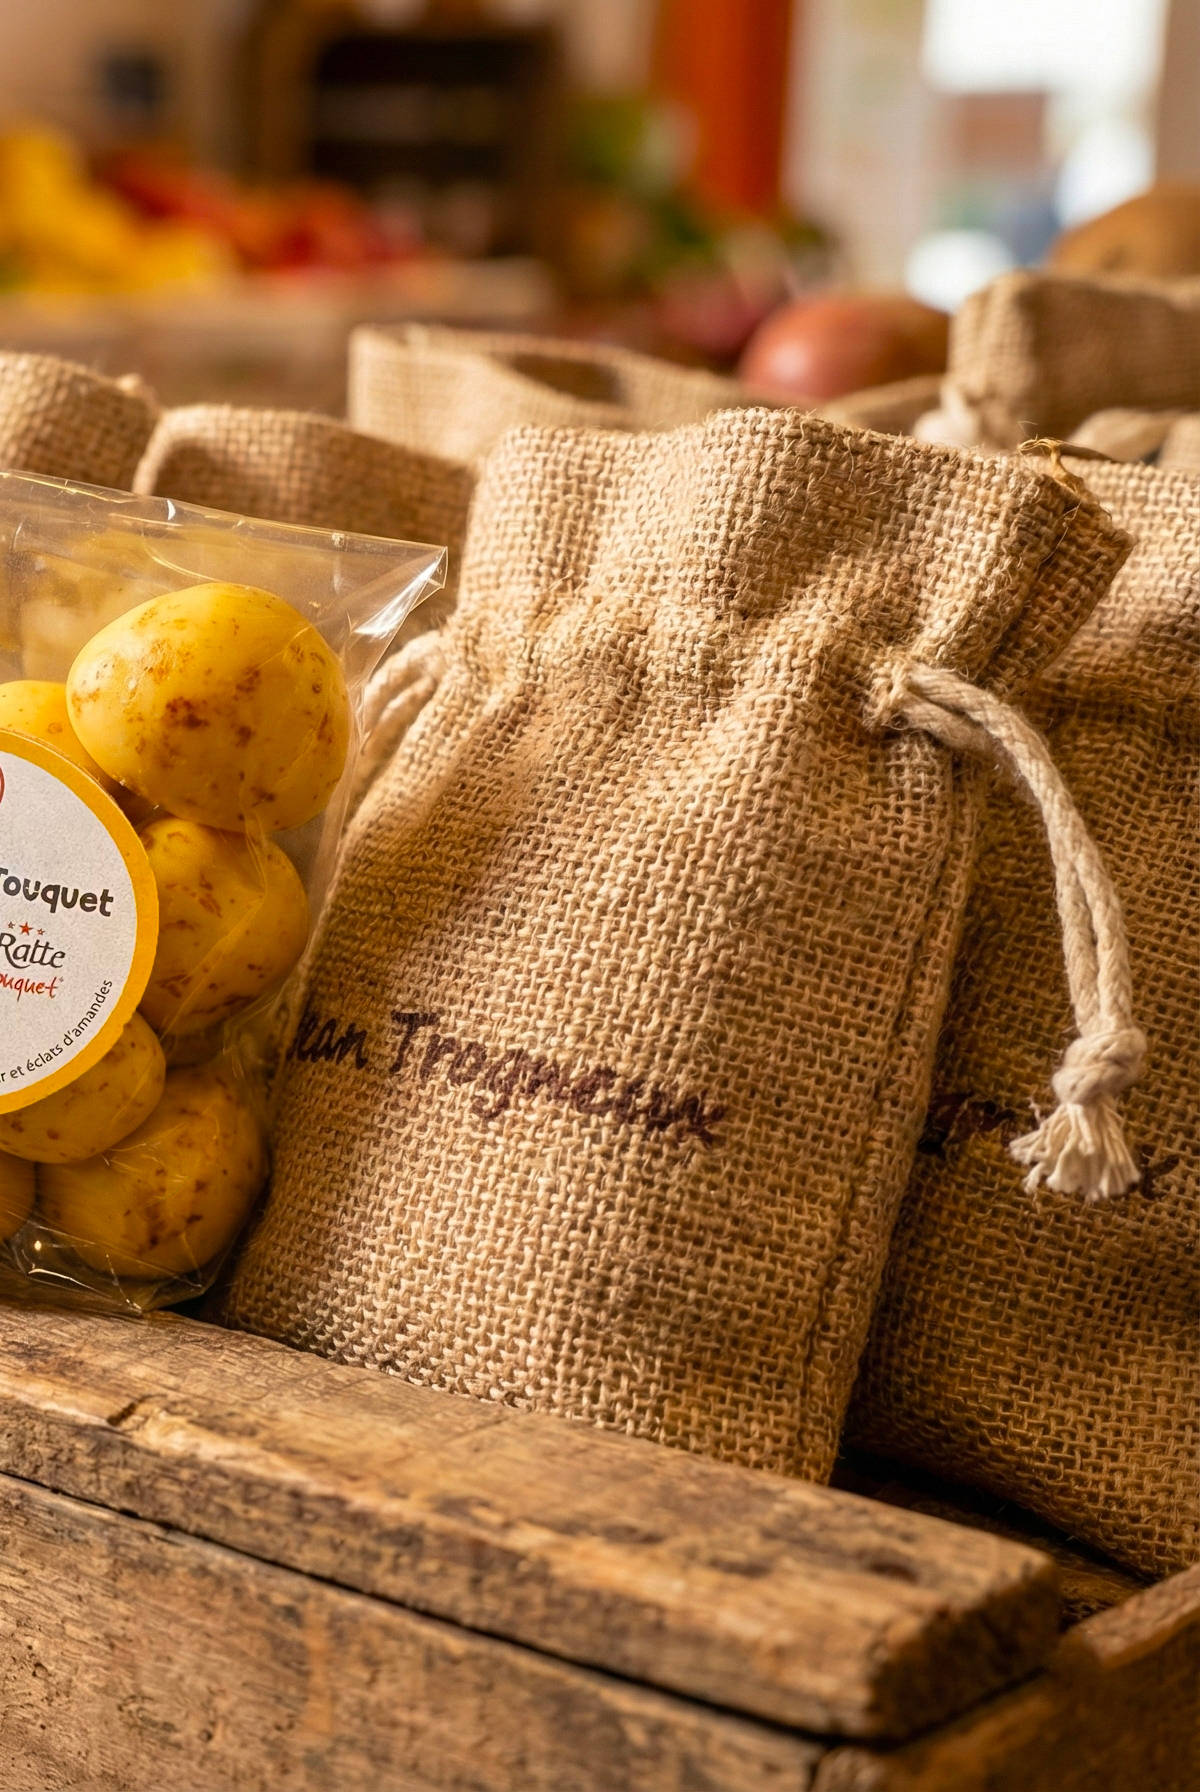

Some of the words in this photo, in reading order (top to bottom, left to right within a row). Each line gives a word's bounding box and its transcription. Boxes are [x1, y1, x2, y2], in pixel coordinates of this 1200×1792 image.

[9, 1066, 25, 1079] et
[26, 1044, 64, 1072] éclats
[63, 980, 113, 1046] d'amandes
